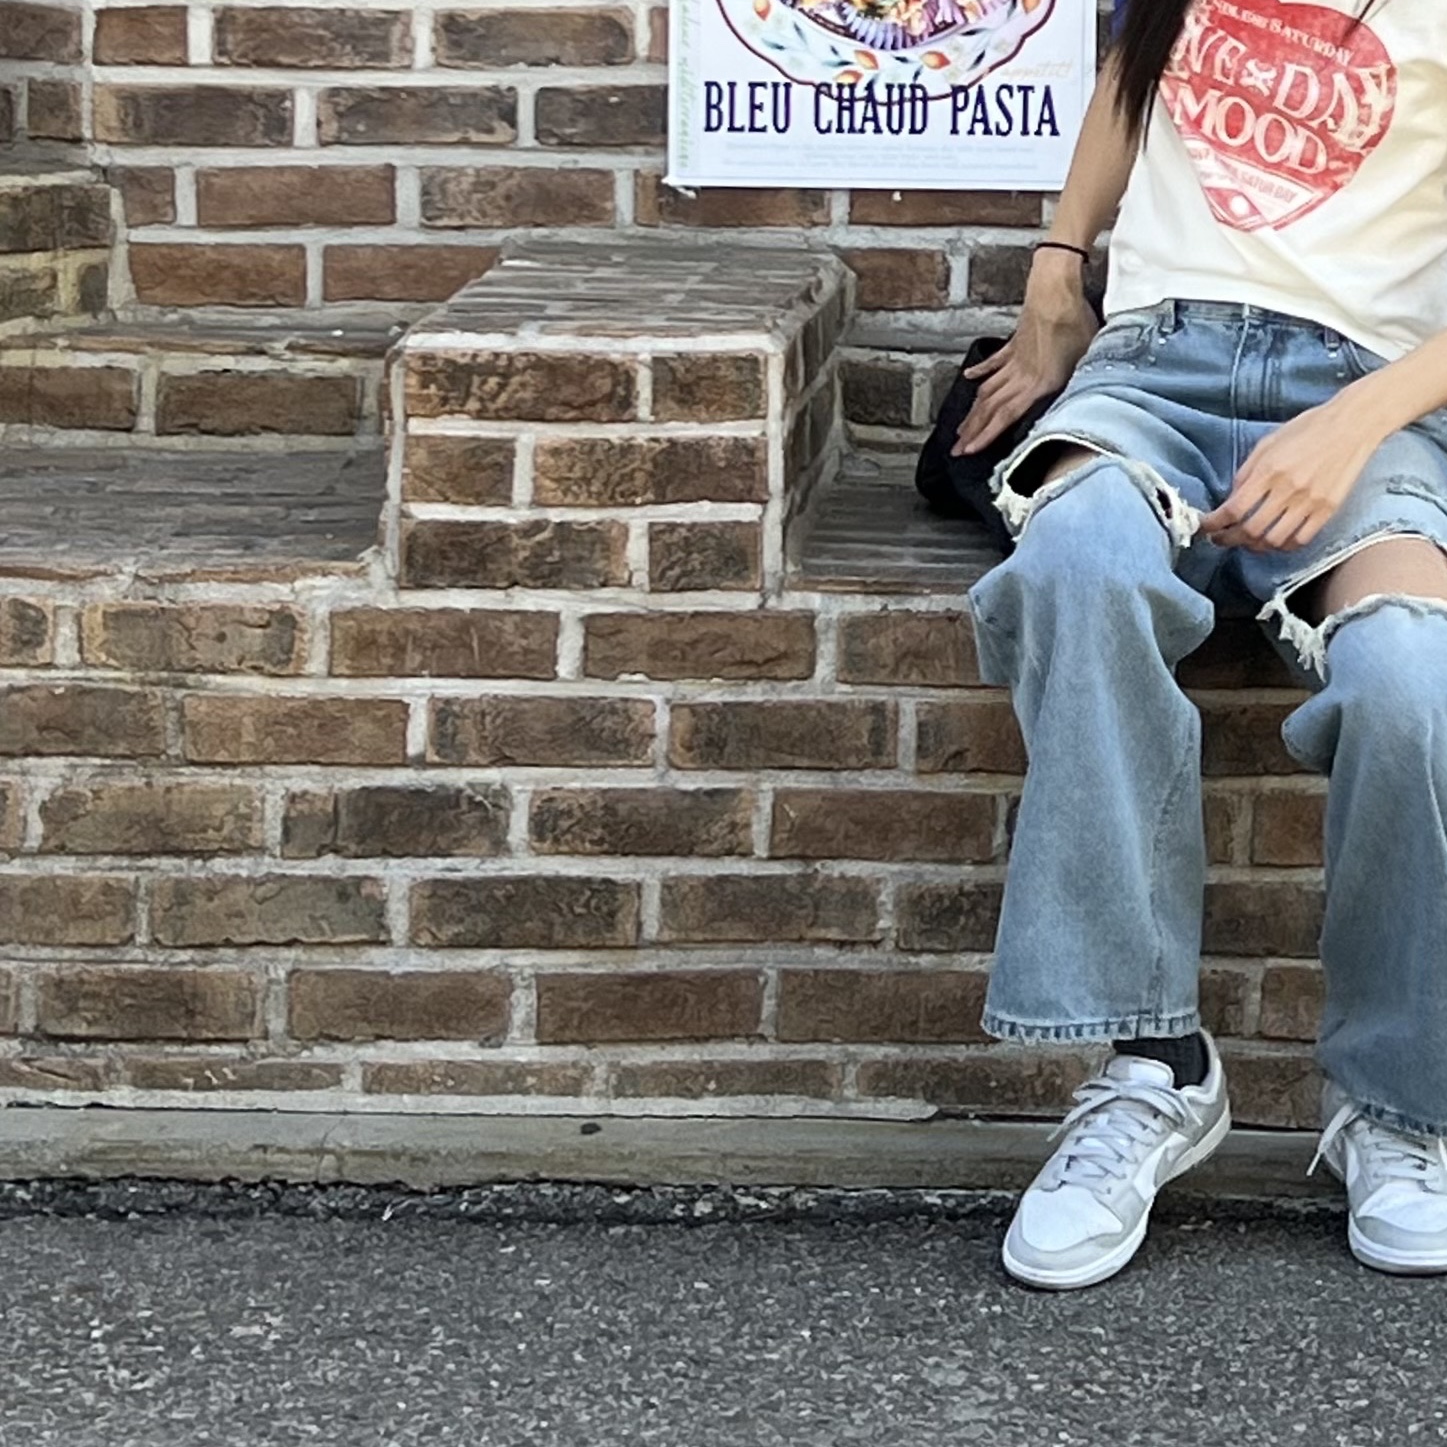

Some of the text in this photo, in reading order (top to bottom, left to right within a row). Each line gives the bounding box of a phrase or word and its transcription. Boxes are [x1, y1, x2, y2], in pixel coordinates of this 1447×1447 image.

[703, 80, 1061, 137] BLEU CHAUD PASTA
[1172, 82, 1328, 175] MOOD
[1271, 60, 1394, 154] DAY
